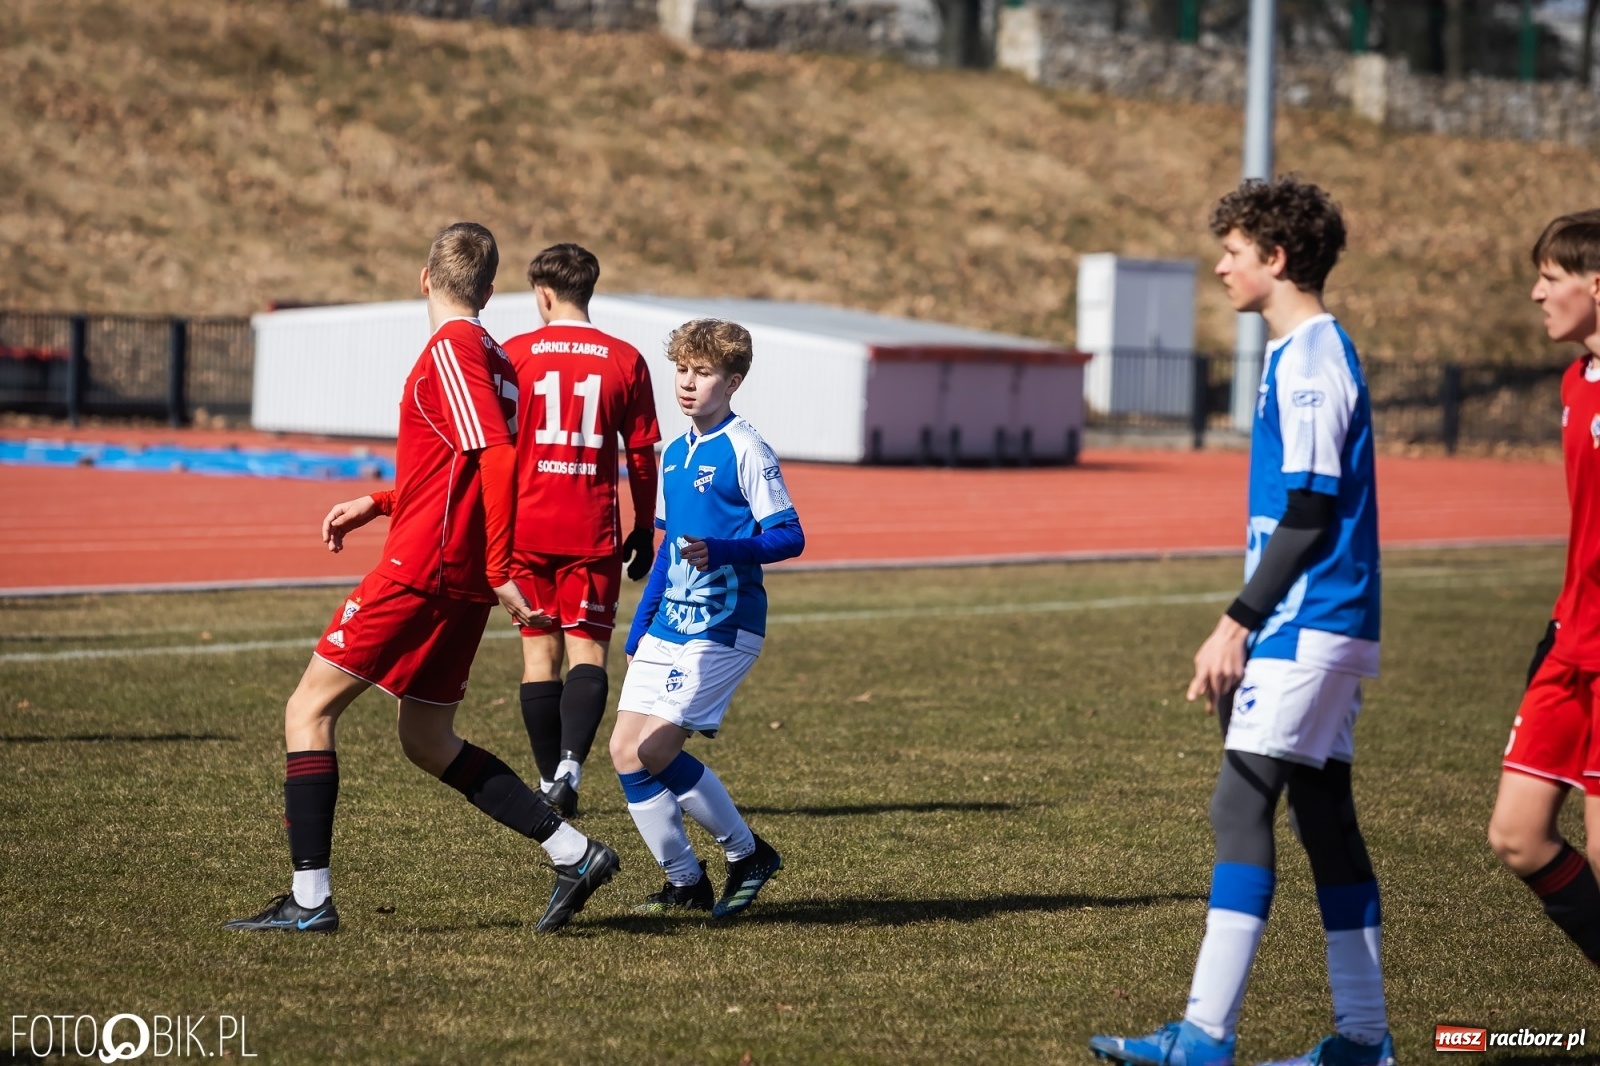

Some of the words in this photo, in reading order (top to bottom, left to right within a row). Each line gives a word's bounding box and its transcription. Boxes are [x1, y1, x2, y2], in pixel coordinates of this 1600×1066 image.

[531, 339, 571, 355] GÓRNIK
[571, 342, 609, 359] ZABRZE
[533, 370, 604, 449] 11
[537, 459, 568, 474] SOCIOS
